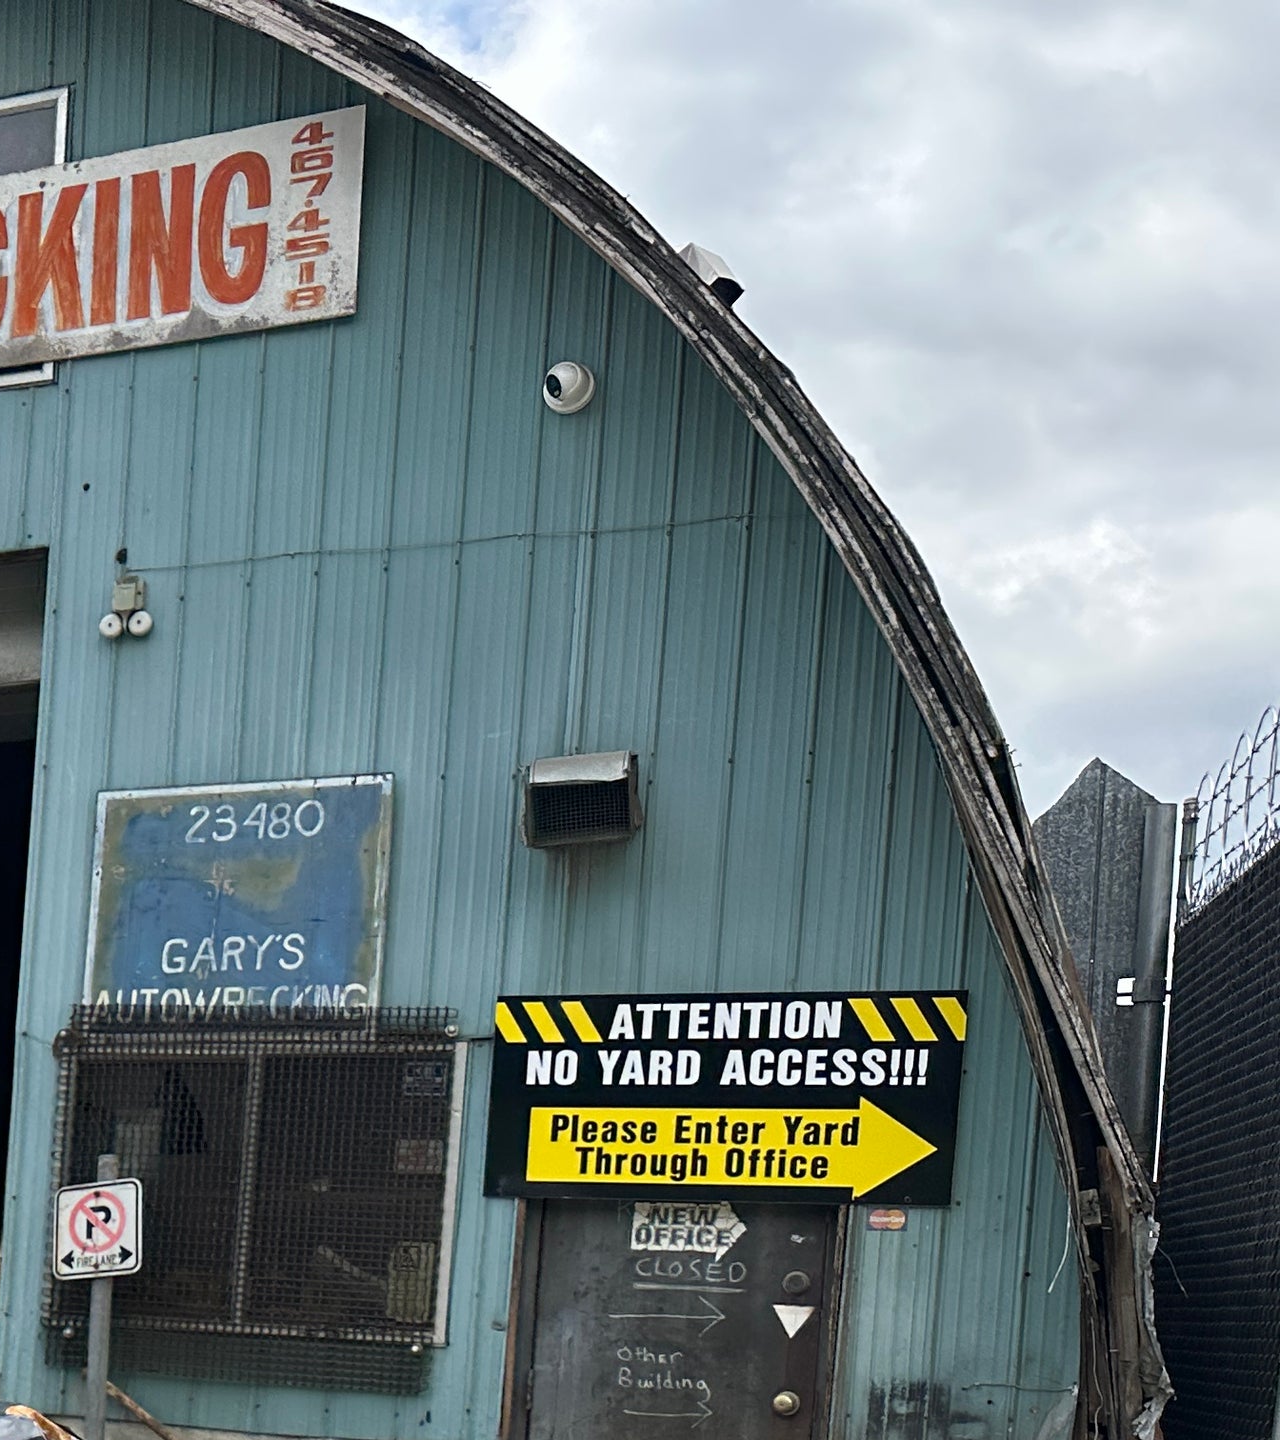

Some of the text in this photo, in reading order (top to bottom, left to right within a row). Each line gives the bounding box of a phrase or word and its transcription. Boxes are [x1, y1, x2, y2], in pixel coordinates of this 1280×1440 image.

[184, 799, 325, 843] 23480
[161, 932, 306, 976] GARY'S
[607, 1000, 843, 1040] ATTENTION
[525, 1048, 930, 1087] NO YARD ACCESS!!!
[550, 1114, 860, 1146] Please Enter Yard
[575, 1147, 828, 1182] Through Office
[650, 1205, 716, 1226] NEW
[635, 1224, 733, 1247] OFFICE
[76, 1253, 118, 1268] FIRE LANE
[635, 1258, 746, 1282] CLOSED
[617, 1346, 683, 1364] Other
[619, 1366, 711, 1403] Building
